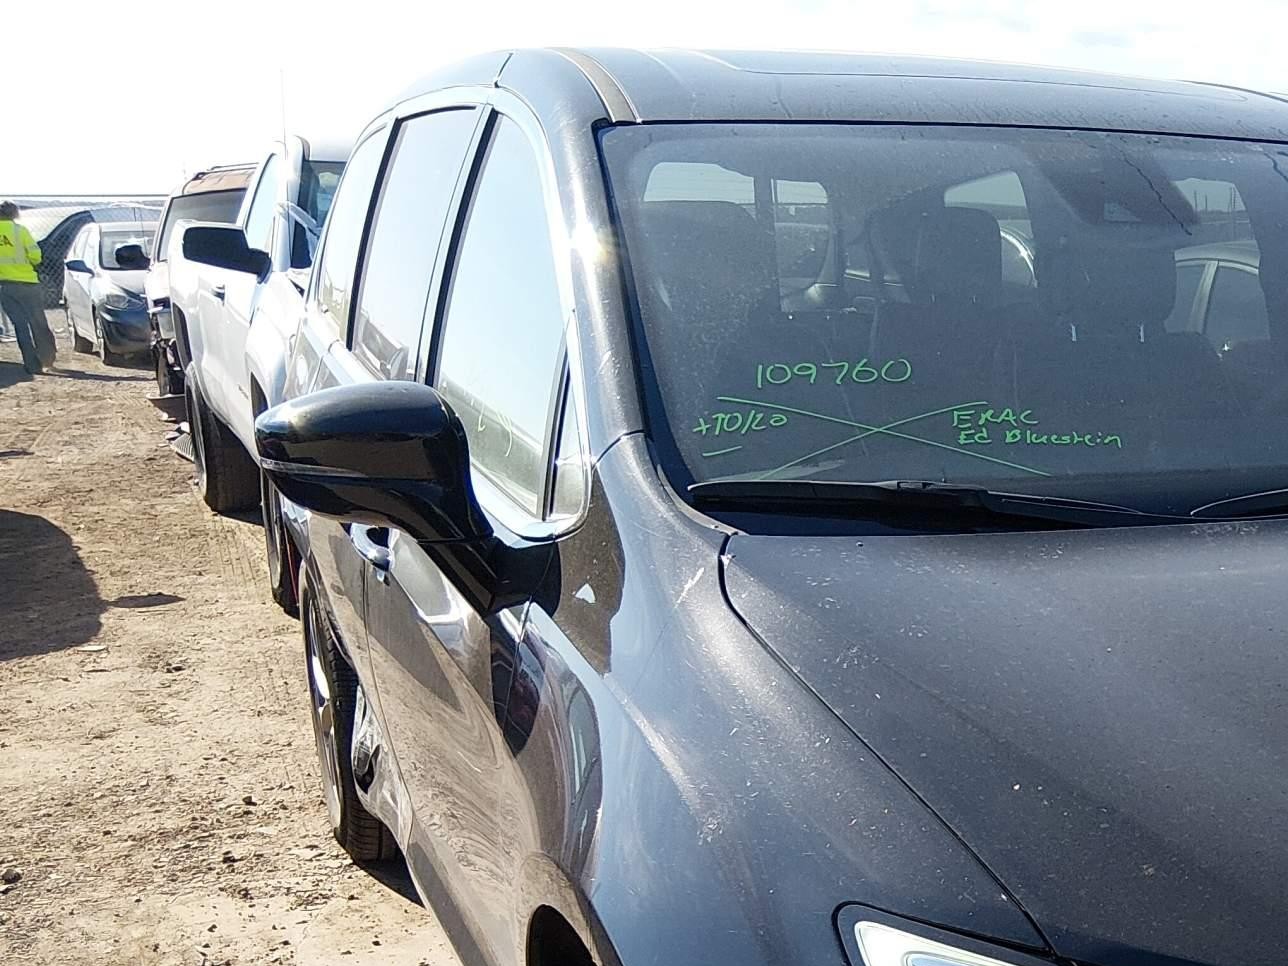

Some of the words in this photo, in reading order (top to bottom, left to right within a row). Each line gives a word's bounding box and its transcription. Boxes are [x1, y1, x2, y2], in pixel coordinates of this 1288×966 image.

[756, 358, 912, 389] 109760
[952, 408, 1038, 428] ERAC
[958, 428, 992, 445] Ed
